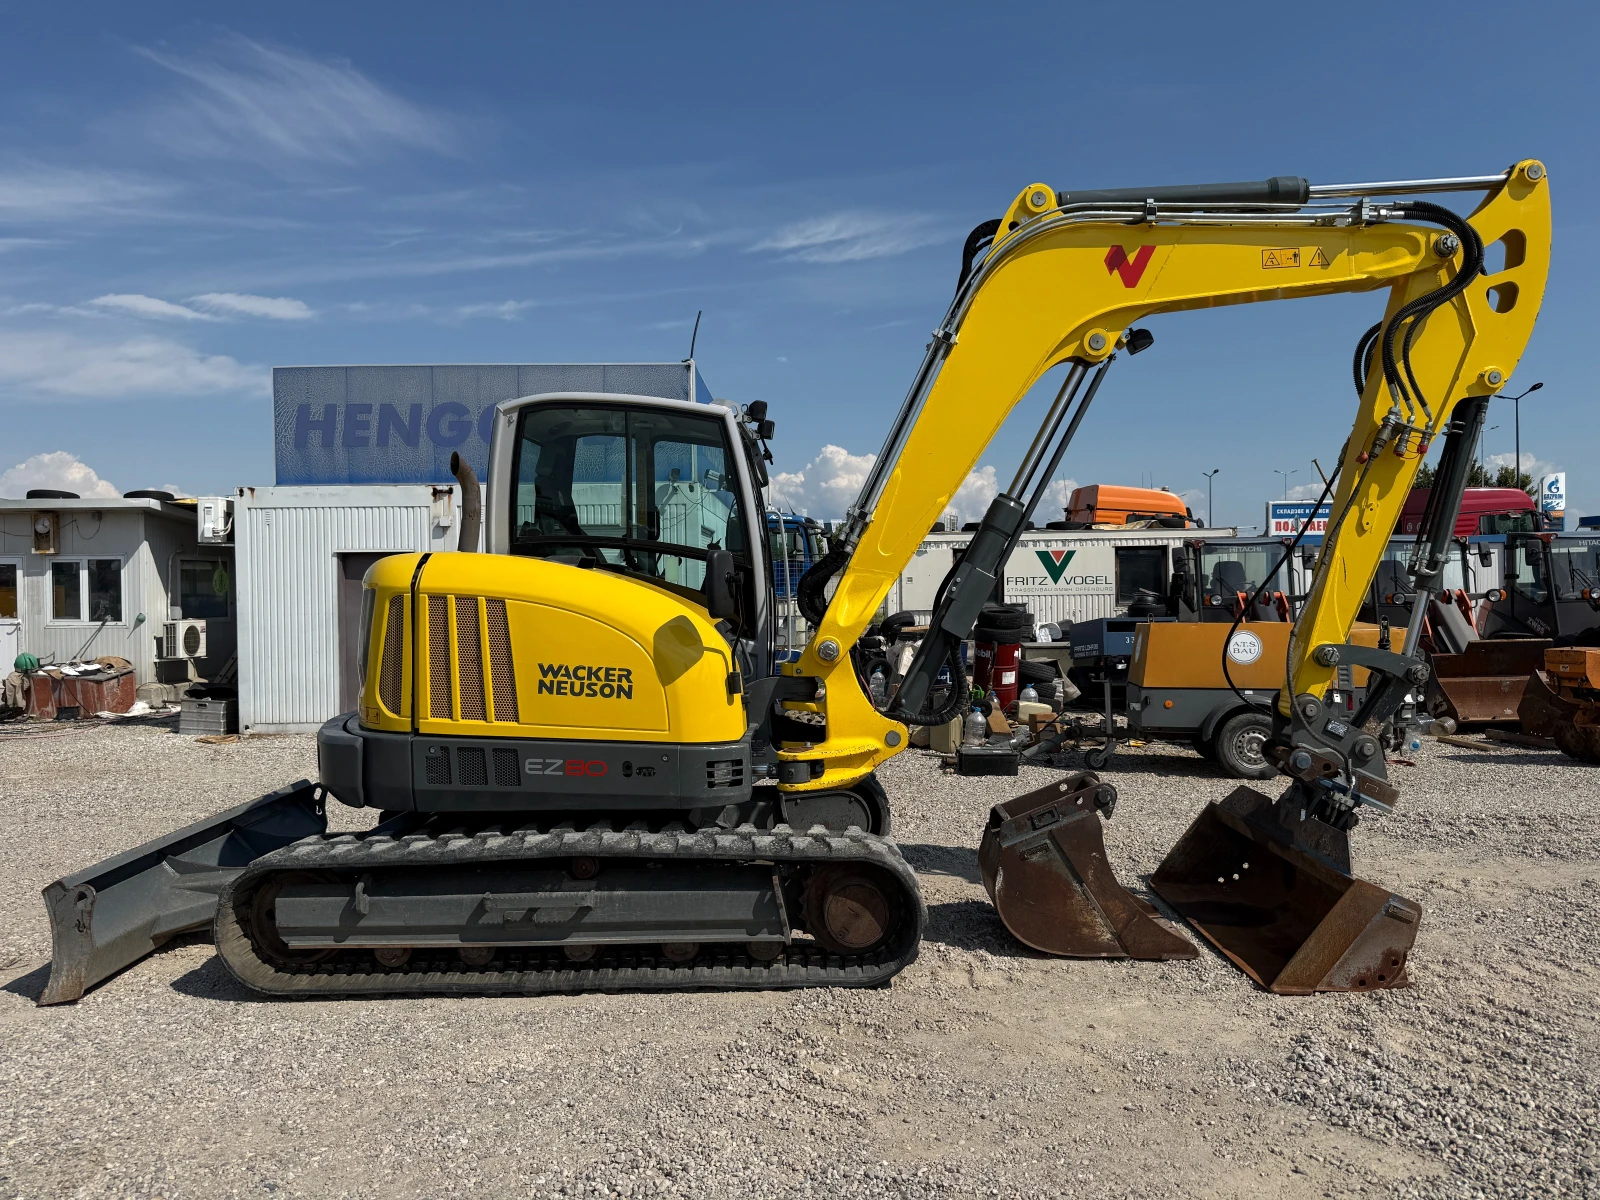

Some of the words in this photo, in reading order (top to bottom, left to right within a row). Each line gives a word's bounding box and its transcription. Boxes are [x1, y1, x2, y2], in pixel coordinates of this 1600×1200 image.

[294, 402, 496, 449] HENG
[1006, 576, 1048, 586] FRITZ
[1063, 575, 1113, 585] VOGEL
[537, 662, 633, 684] WACKER
[537, 679, 633, 700] NEUSON
[524, 758, 608, 777] EZ80
